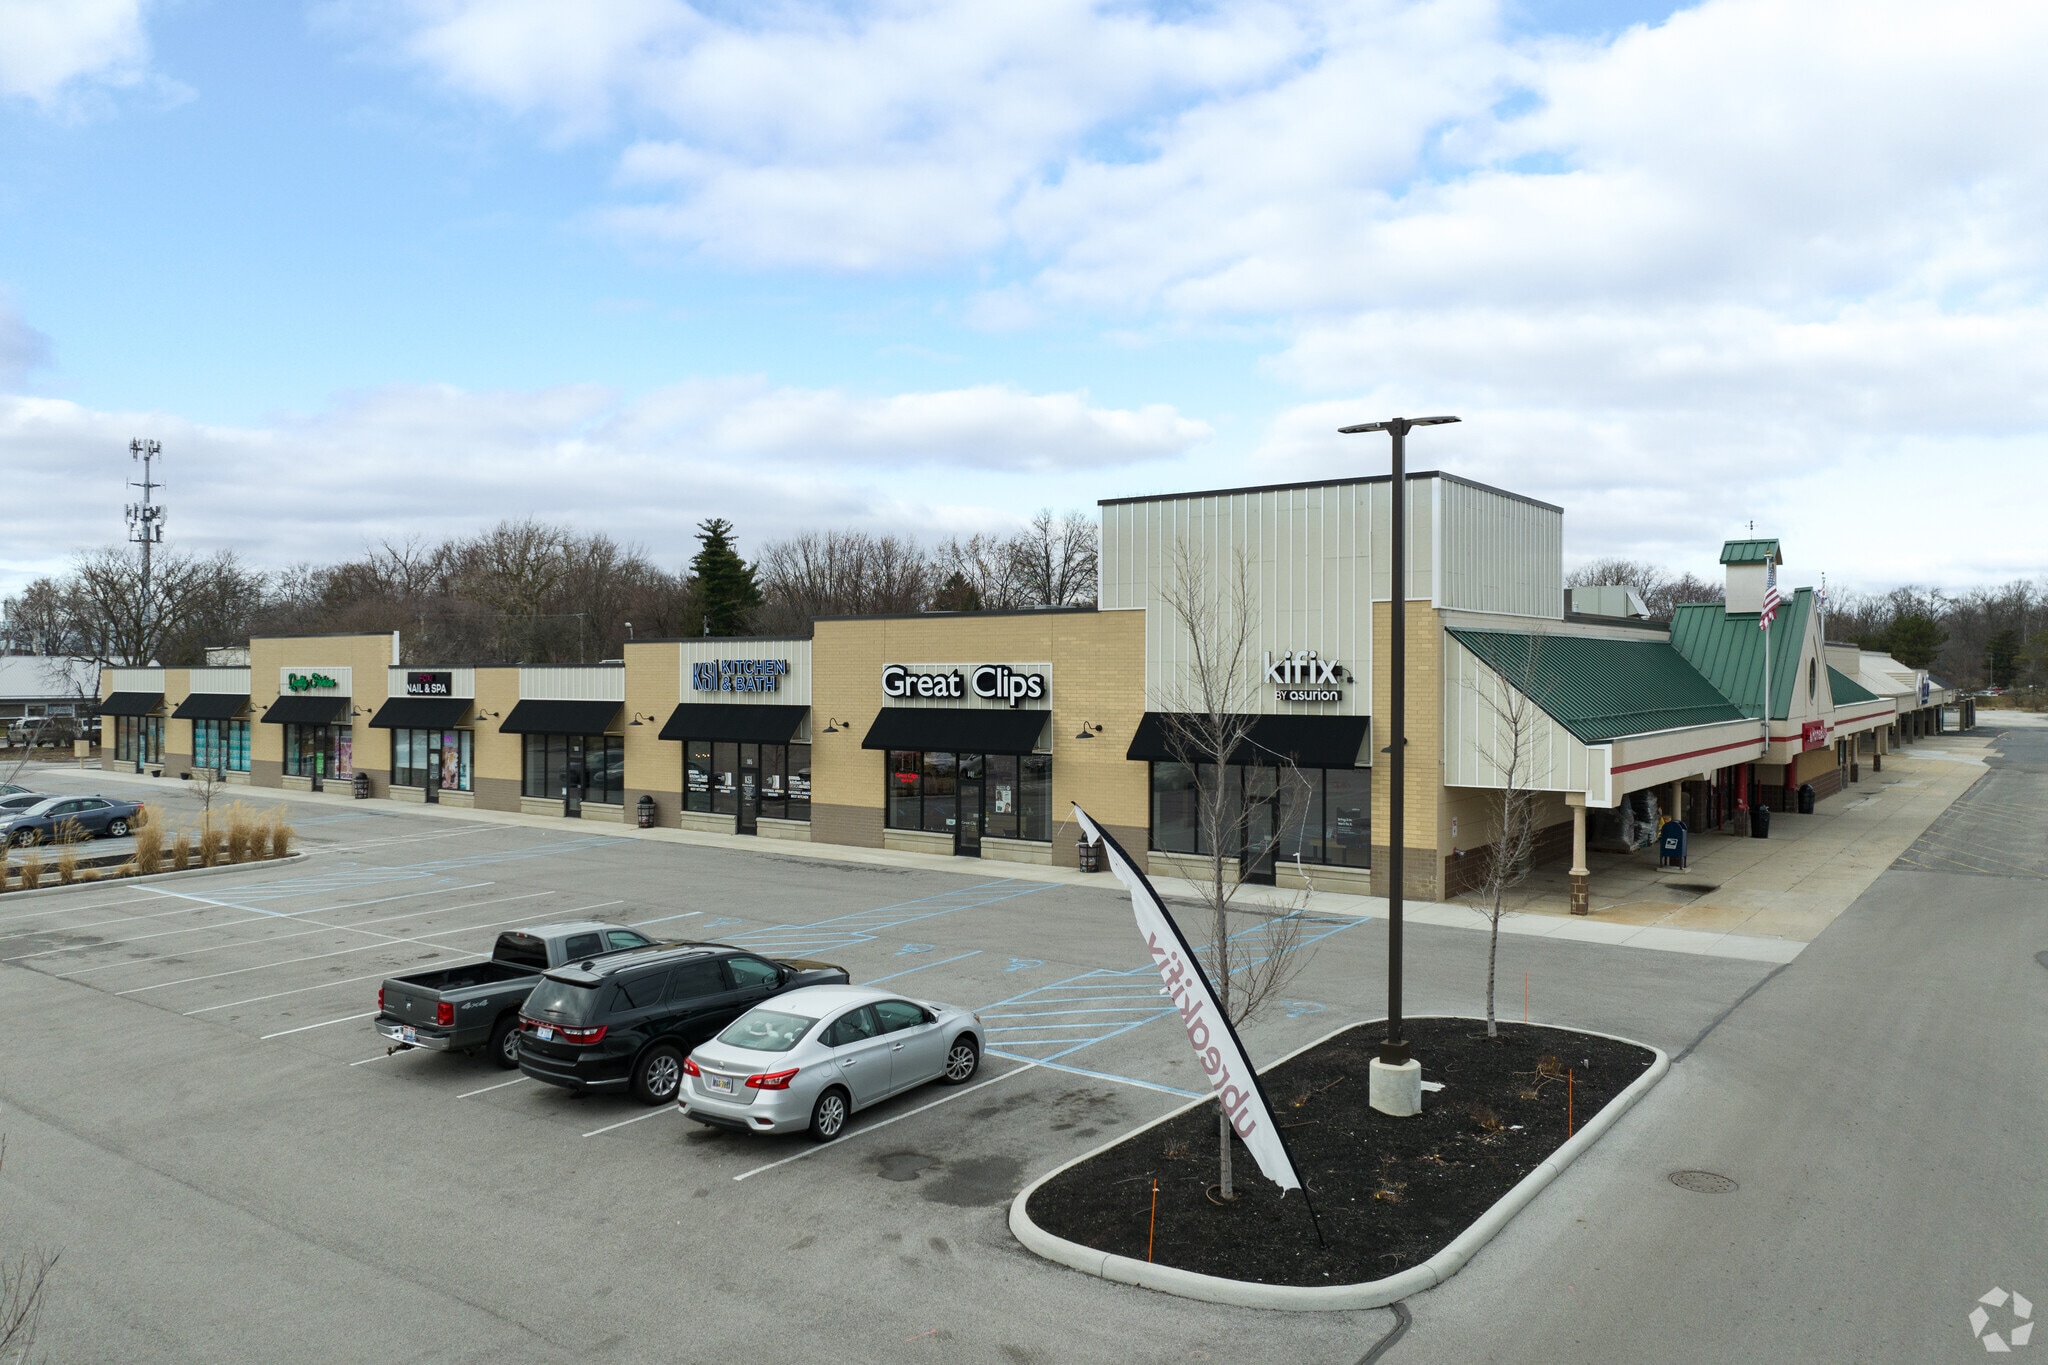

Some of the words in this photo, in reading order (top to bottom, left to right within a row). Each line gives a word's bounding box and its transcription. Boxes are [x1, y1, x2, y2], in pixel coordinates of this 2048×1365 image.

[721, 659, 786, 675] KITCHEN
[1264, 650, 1339, 684] kifix
[406, 683, 424, 693] NAIL
[424, 683, 430, 693] &
[431, 683, 447, 693] SPA
[721, 676, 732, 692] &
[735, 676, 776, 693] BATH
[881, 666, 961, 697] Great
[971, 666, 1042, 707] Clips
[1275, 690, 1287, 701] BY
[1289, 688, 1338, 701] asurion
